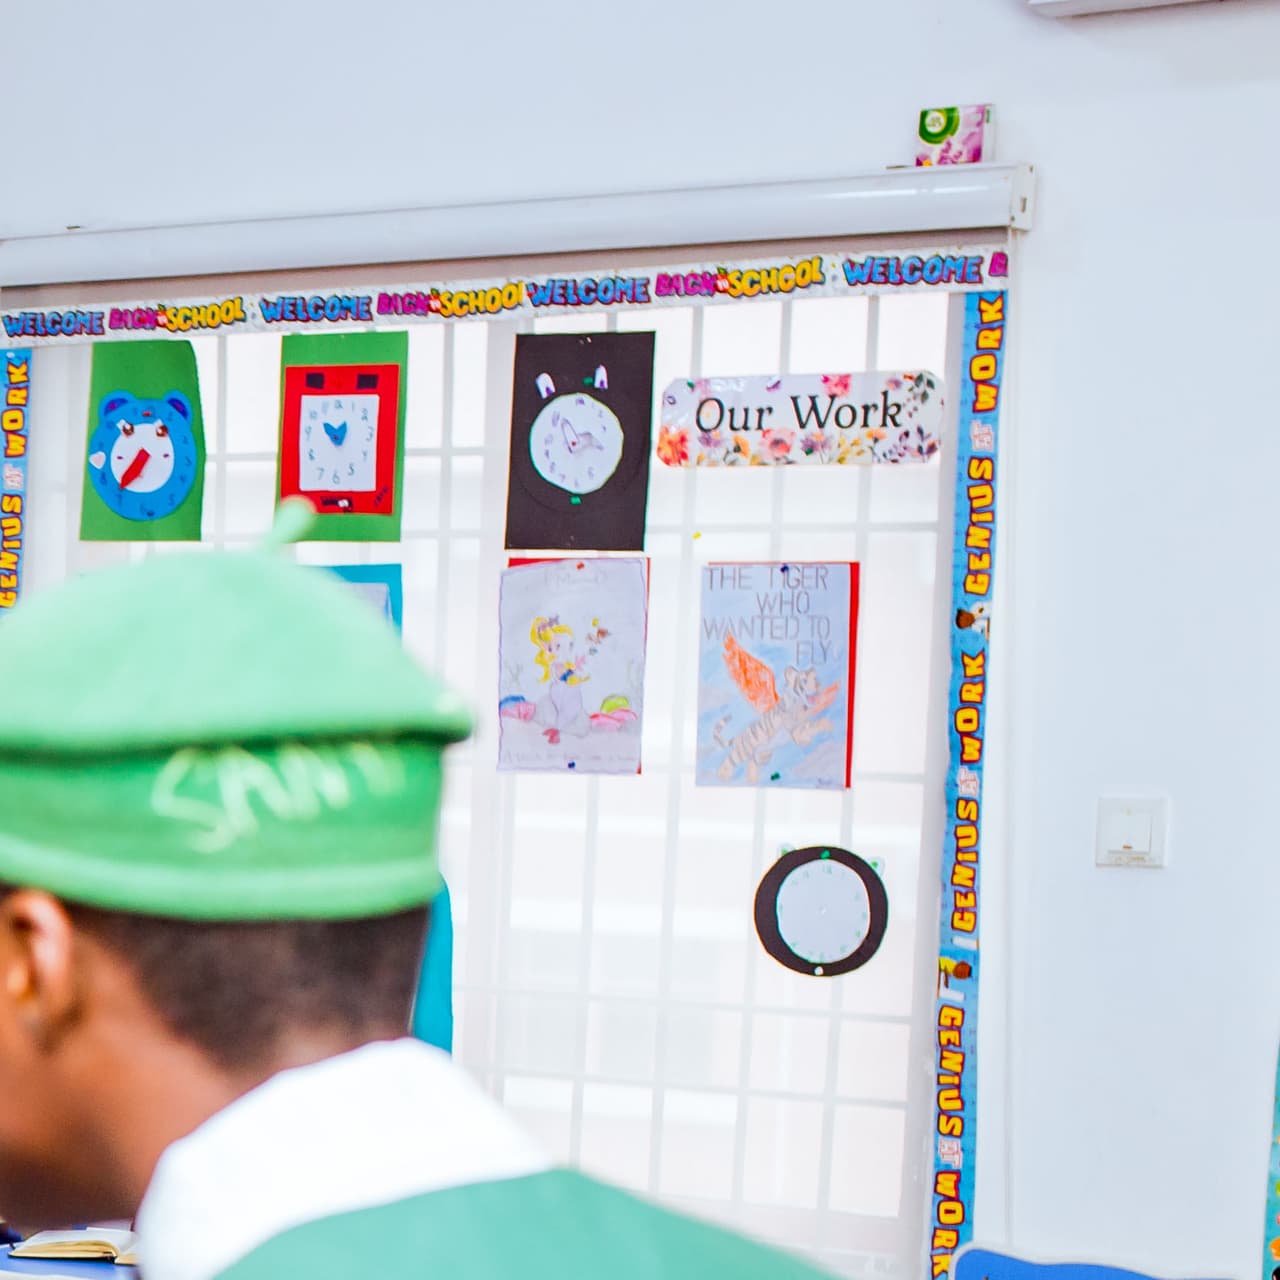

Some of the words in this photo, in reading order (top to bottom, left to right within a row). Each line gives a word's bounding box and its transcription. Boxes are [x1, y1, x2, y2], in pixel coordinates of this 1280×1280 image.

[2, 311, 105, 338] WELCOME
[109, 308, 158, 330] BACK
[166, 297, 246, 332] SCHOOL
[259, 295, 374, 323] WELCOME
[376, 292, 430, 316] BACK
[530, 276, 651, 307] WELCOME
[655, 273, 718, 297] BACK
[729, 256, 825, 298] SCHOOL
[842, 255, 985, 288] WELCOME
[969, 294, 1006, 414] WORK
[1, 360, 30, 458] WORK
[695, 397, 774, 433] Our
[790, 390, 903, 430] Work
[964, 456, 995, 597] GENIUS
[703, 566, 753, 591] THE
[766, 565, 830, 591] TIGER
[756, 590, 811, 617] WHO
[703, 614, 800, 641] WANTED
[809, 615, 832, 641] TO
[796, 640, 832, 665] FLY
[954, 650, 987, 765] WORK
[951, 797, 979, 934] GENIUS
[936, 1005, 965, 1139] GENIUS
[929, 1170, 965, 1280] WORK
